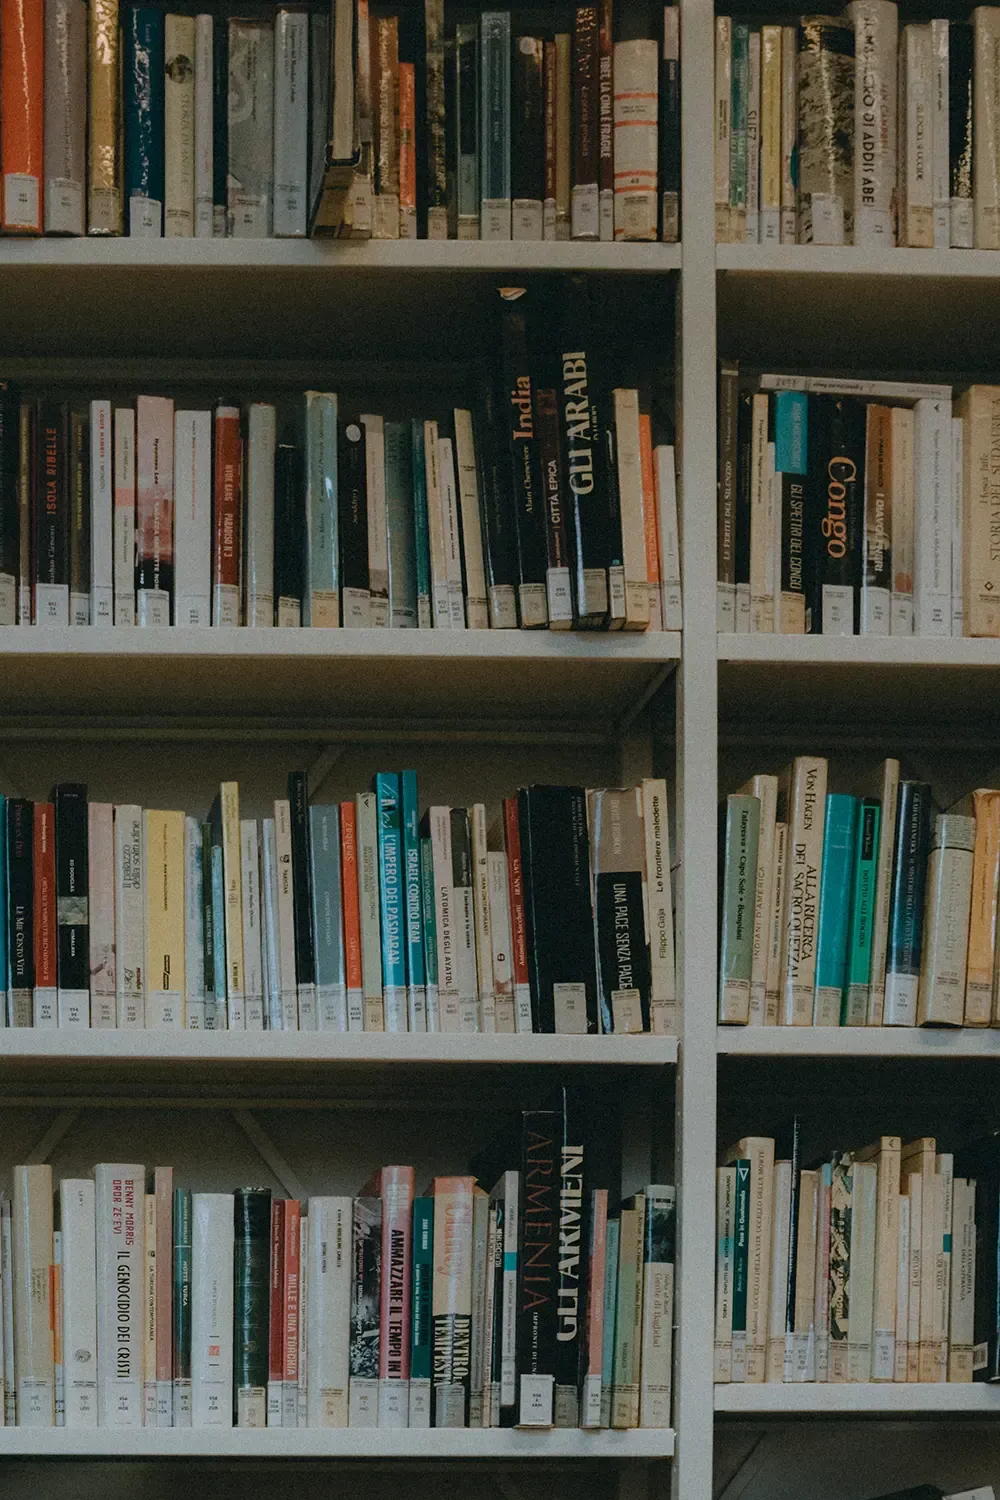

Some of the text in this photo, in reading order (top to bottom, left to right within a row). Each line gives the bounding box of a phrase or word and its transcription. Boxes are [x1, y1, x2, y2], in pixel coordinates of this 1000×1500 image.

[863, 132, 875, 173] ADDIS
[511, 375, 534, 440] India
[561, 351, 595, 495] GLI ARABI
[46, 427, 57, 515] ISOLA RIBELLE
[547, 459, 560, 524] CITTÀ EPICA
[723, 460, 732, 501] SILENZIO
[989, 480, 1000, 506] DEL
[724, 501, 732, 518] DEL
[724, 519, 733, 548] FERITE
[790, 484, 803, 590] GLI SPETTRI DEL CONGO
[820, 455, 858, 560] Congo
[989, 511, 1000, 562] STORIA
[803, 768, 818, 830] VON HAGEN
[131, 820, 141, 890] della solitudine
[735, 810, 749, 941] Talayesva Capo Sole Bompiani
[384, 834, 400, 965] L'IMPERO DEI PASDARAN
[408, 848, 420, 943] ISRAELE CONTRO IRAN
[753, 865, 765, 960] INDIANI D'AMERICA
[786, 843, 806, 979] DEL SACRO QUETZAL
[801, 864, 816, 960] ALLA RICERCA
[613, 883, 632, 990] UNA PACE SENZA PACE
[658, 907, 668, 959] Filippo Gaja
[112, 1179, 122, 1235] DROR ZE'EVI
[124, 1179, 134, 1247] BENNY MORRIS
[523, 1131, 553, 1310] ARMENIA
[556, 1144, 584, 1342] GLI ARMENI
[116, 1250, 131, 1379] IL GENOCIDIO DEI CRISTI
[286, 1273, 297, 1302] MILLE
[388, 1228, 405, 1373] AMMAZZARE IL TEMPO IN
[286, 1313, 298, 1332] UNA
[287, 1335, 298, 1376] TURCHIA
[433, 1317, 452, 1386] TEMPESTA
[452, 1317, 471, 1377] DENTRO
